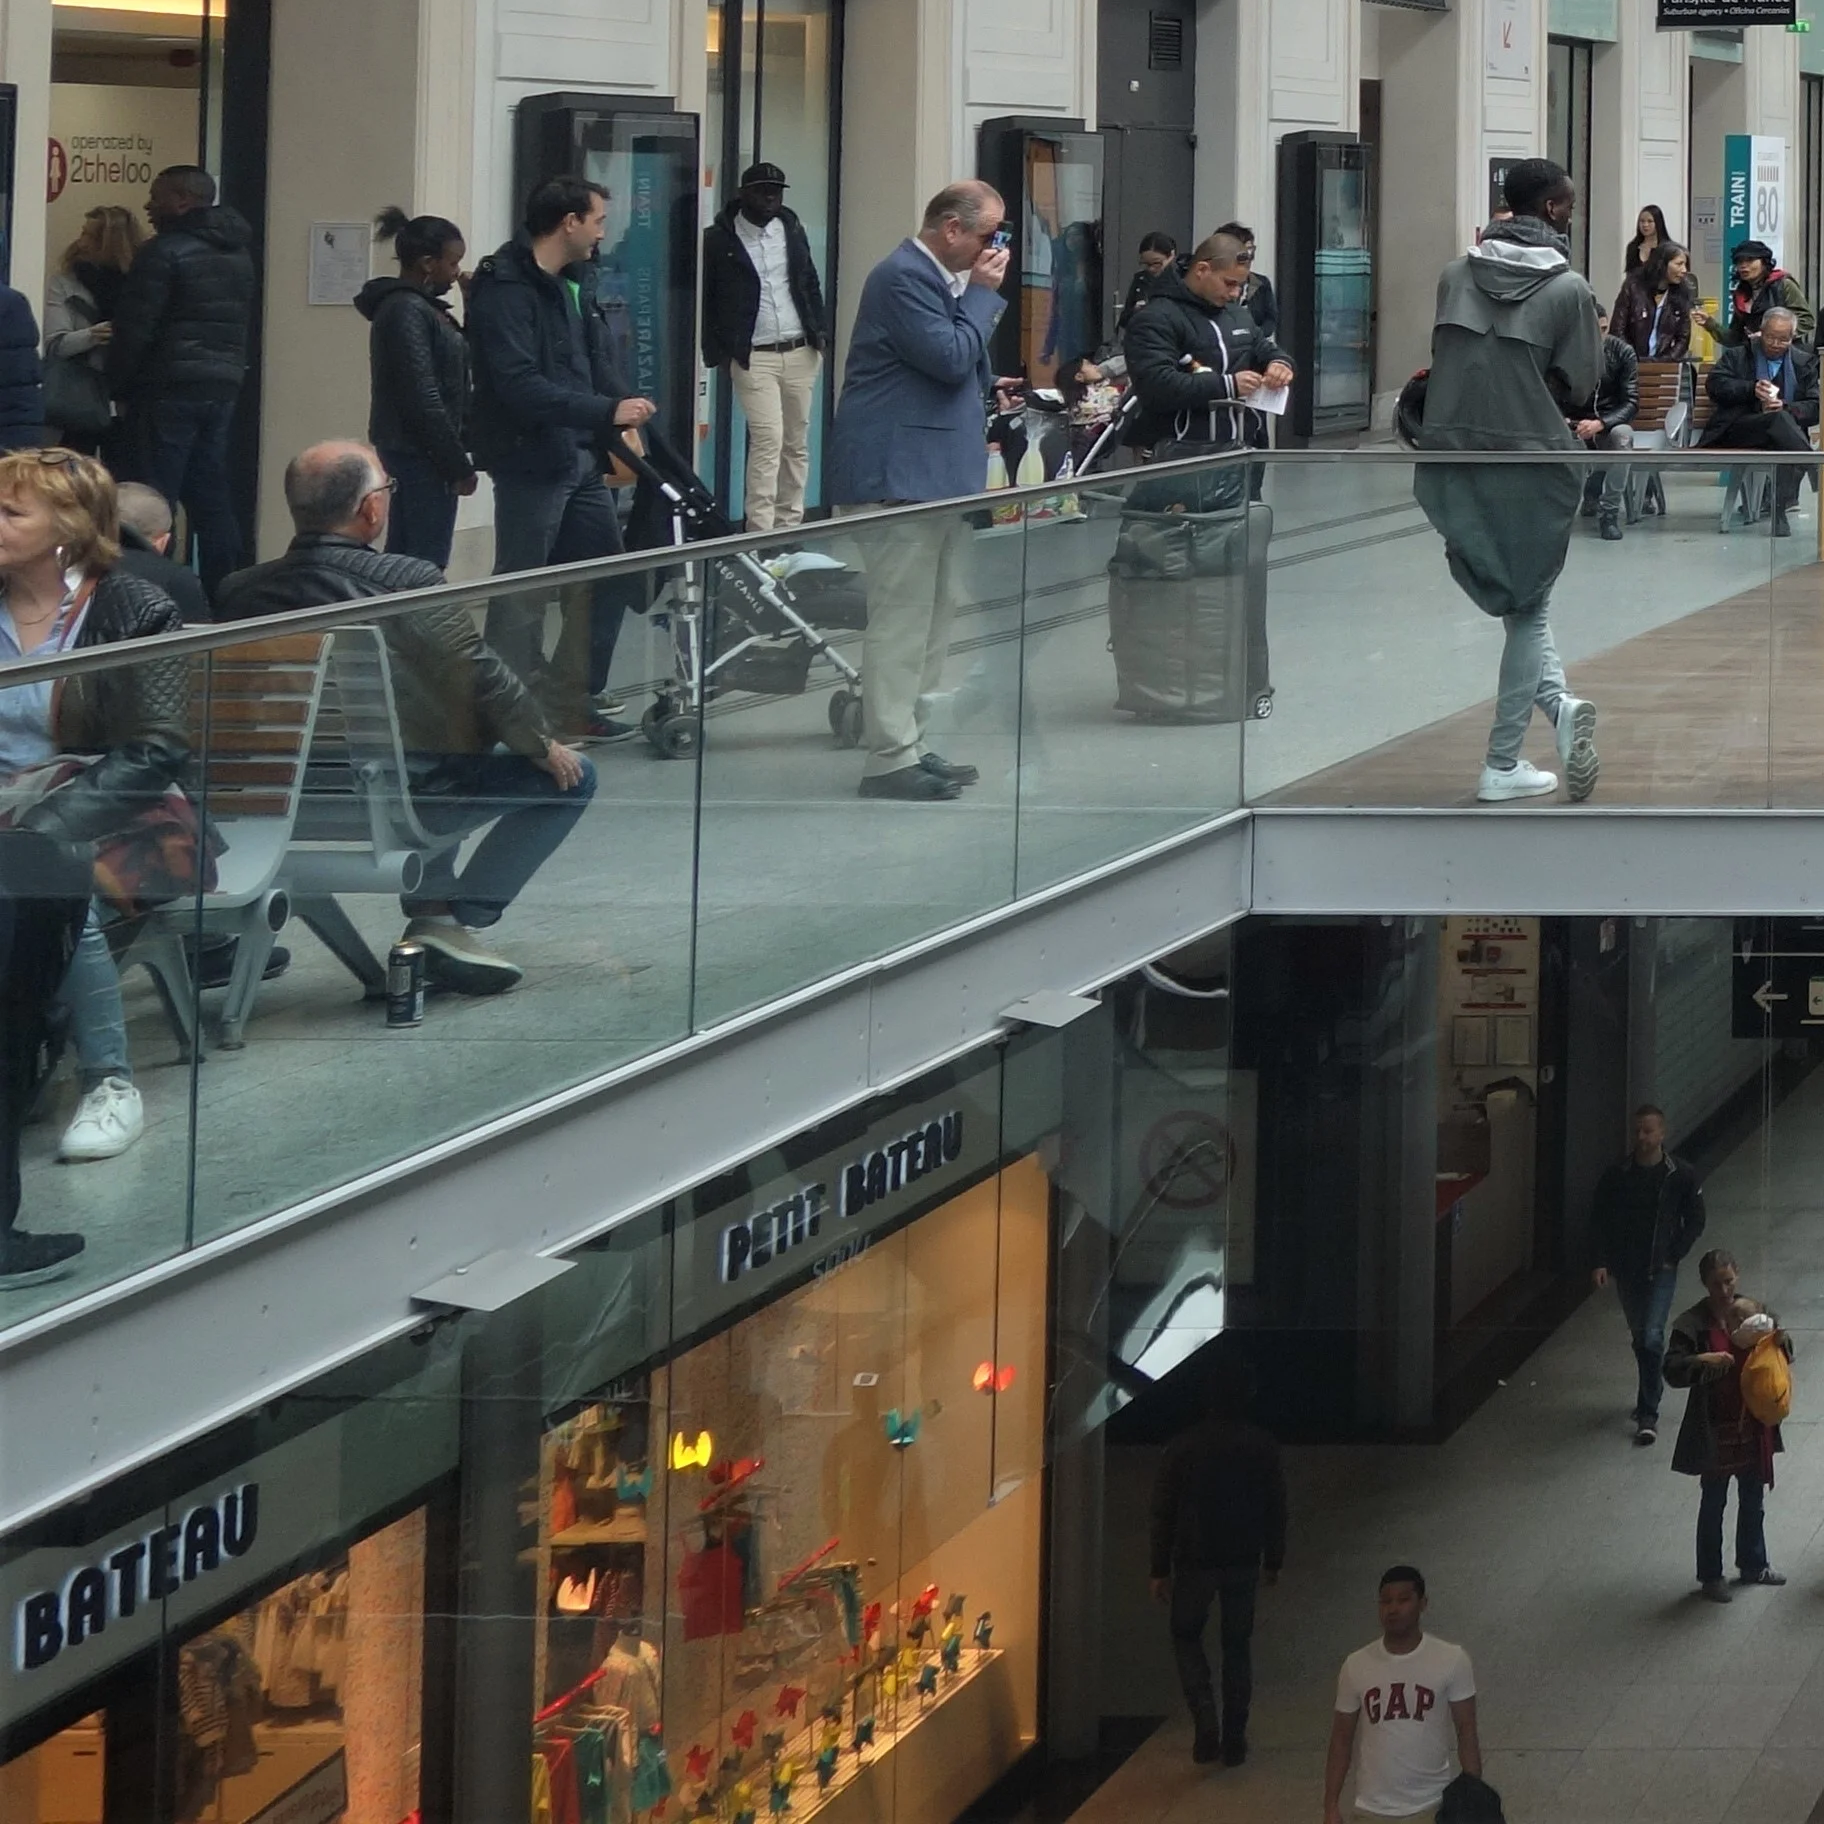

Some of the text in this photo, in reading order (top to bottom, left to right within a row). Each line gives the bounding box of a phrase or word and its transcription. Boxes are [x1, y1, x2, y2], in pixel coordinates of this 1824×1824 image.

[71, 133, 153, 155] operated by
[70, 153, 152, 184] 2theloo
[1730, 176, 1746, 228] TRAIN
[1756, 185, 1778, 233] 80
[723, 1183, 827, 1283] PETIT
[841, 1110, 963, 1218] BATEAU
[20, 1482, 260, 1671] BATEAU
[1364, 1682, 1436, 1725] GAP
